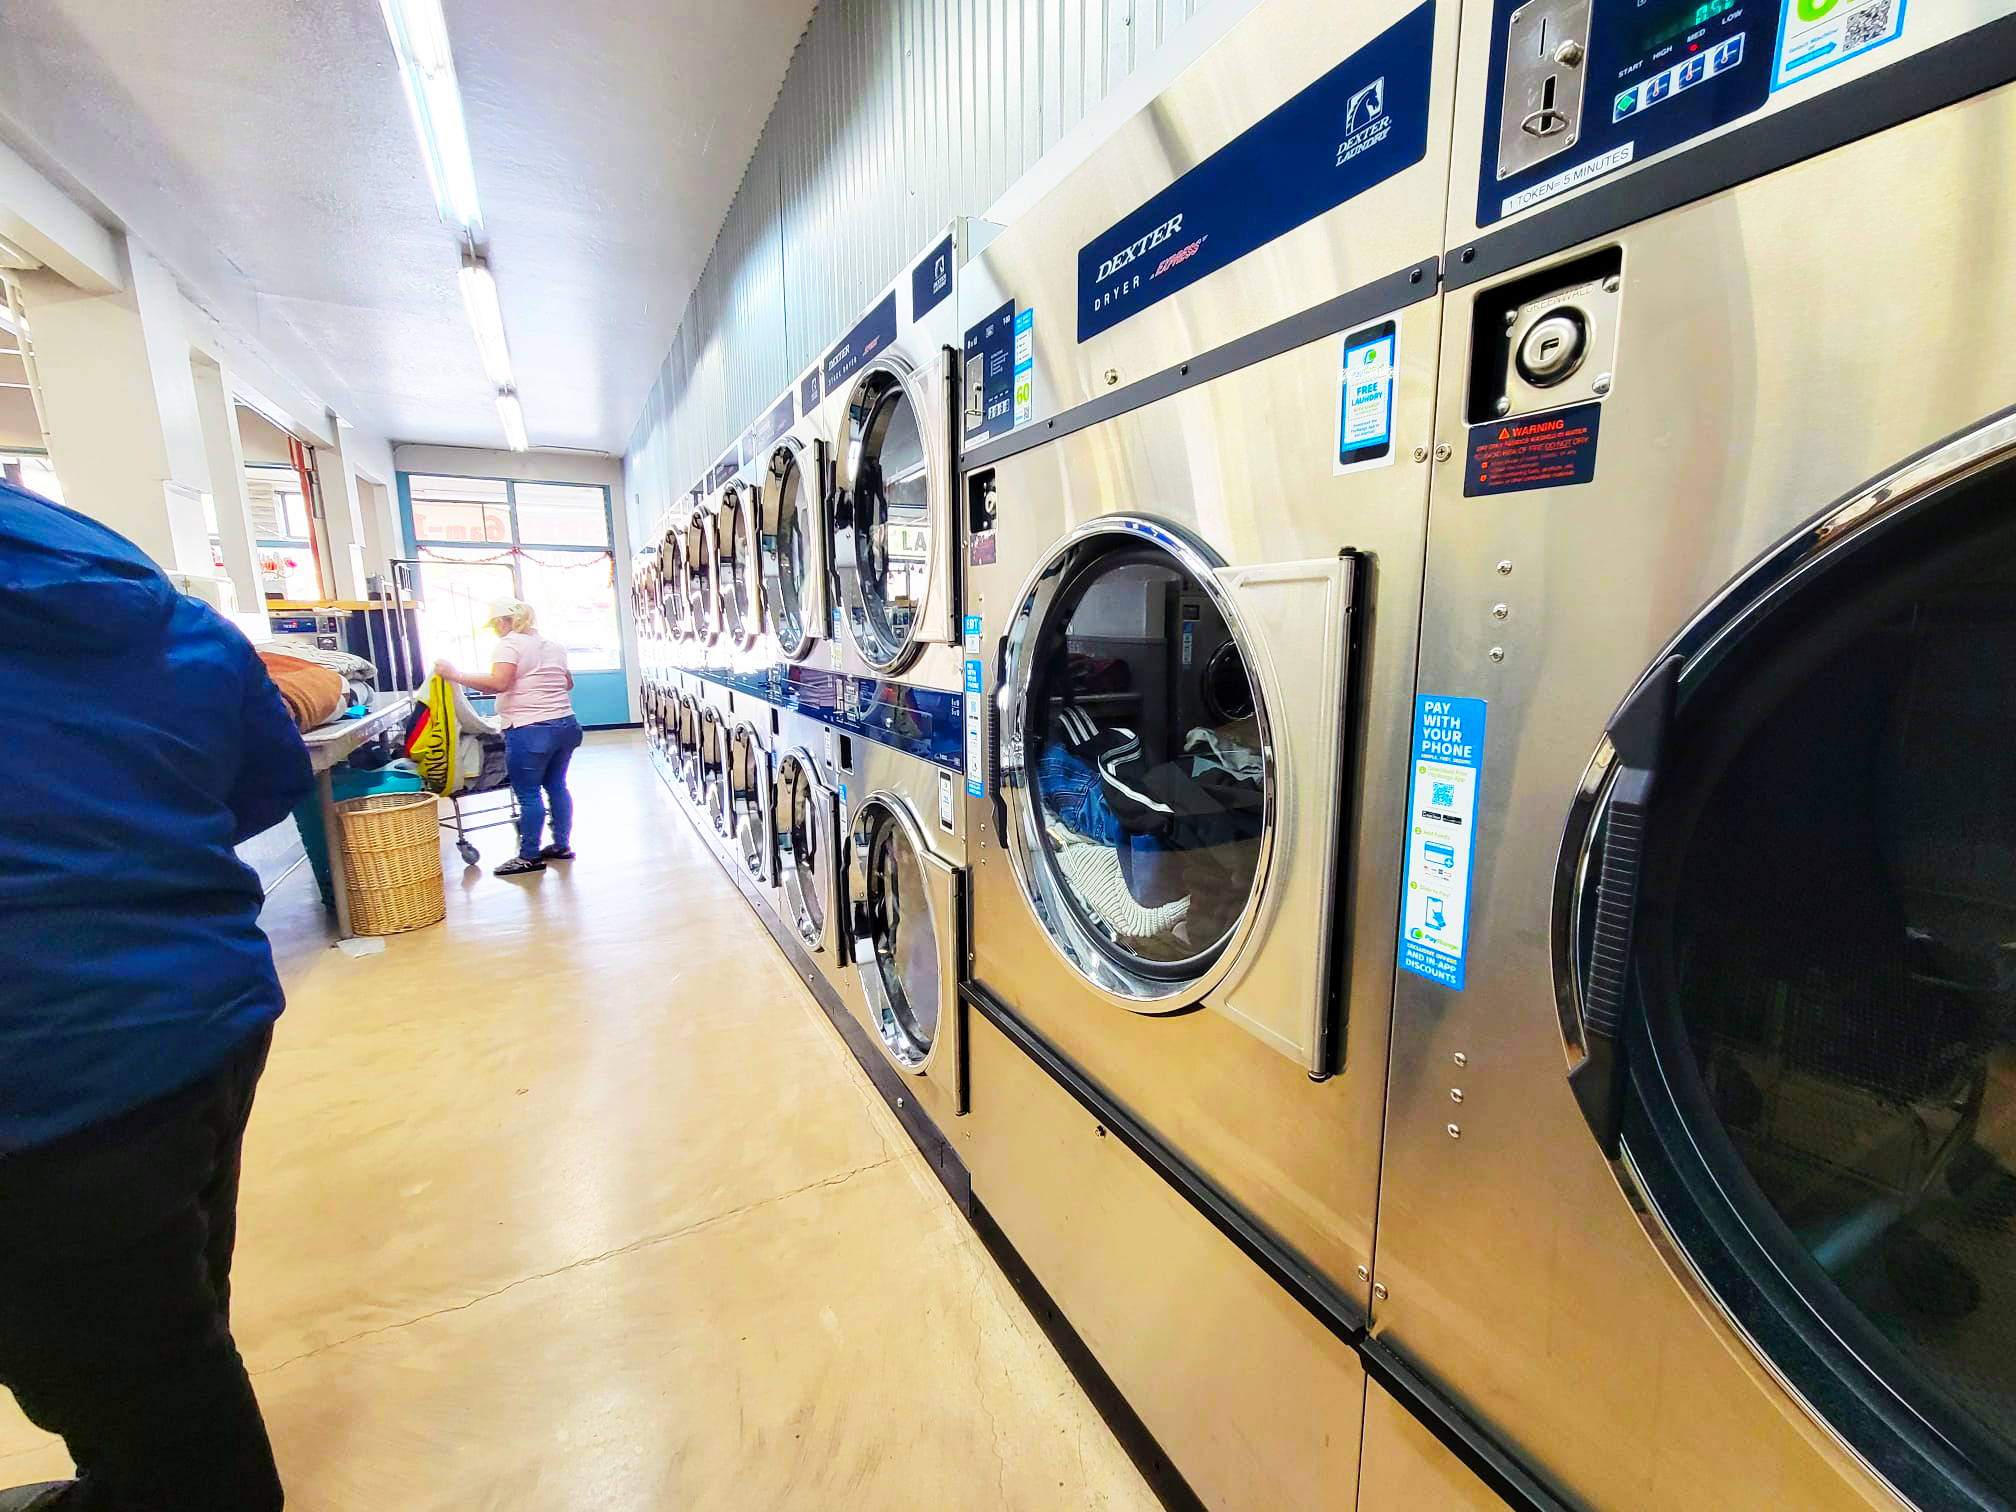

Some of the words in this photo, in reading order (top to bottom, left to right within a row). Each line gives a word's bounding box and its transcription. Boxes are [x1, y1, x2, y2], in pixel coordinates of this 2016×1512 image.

[1618, 60, 1644, 78] START
[1653, 45, 1673, 60] HIGH
[1687, 29, 1706, 43] MED
[1721, 9, 1743, 25] LOW
[1335, 126, 1391, 167] LAUNDRY
[1336, 116, 1390, 156] DEXTER
[1563, 175, 1571, 186] 5
[1573, 148, 1629, 180] MINUTES
[1096, 213, 1183, 284] DEXTER
[1094, 275, 1140, 312] DRYER
[1016, 383, 1030, 406] 60
[1352, 392, 1383, 406] LAUNDRY
[1357, 382, 1378, 396] FREE
[1512, 420, 1564, 437] WARNING
[1424, 701, 1451, 714] PAY
[1423, 714, 1461, 730] WITH
[1422, 727, 1462, 743] YOUR
[1421, 741, 1473, 758] PHONE
[1405, 958, 1457, 984] DISCOUNTS
[1406, 949, 1424, 961] AND
[1426, 956, 1457, 973] IN-APP
